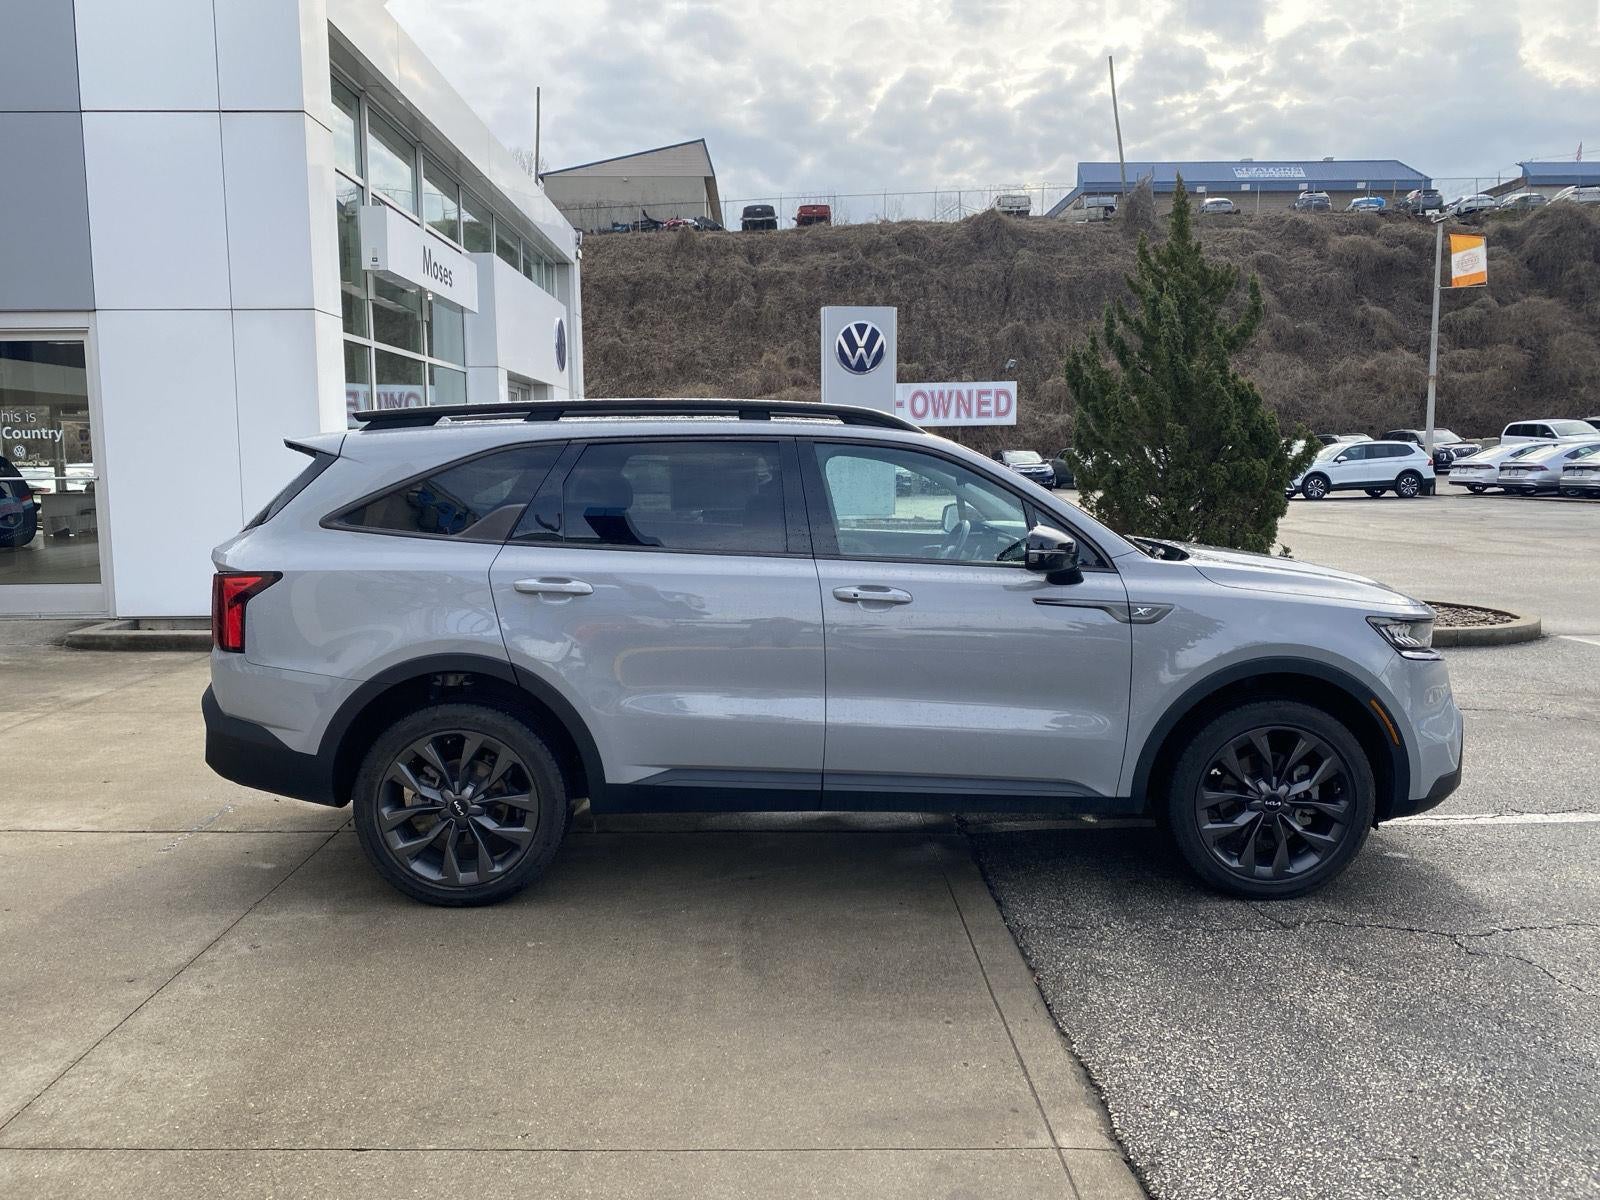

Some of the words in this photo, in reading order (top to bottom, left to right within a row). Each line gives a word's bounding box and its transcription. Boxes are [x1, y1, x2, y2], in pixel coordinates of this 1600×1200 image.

[422, 245, 453, 288] Moses
[836, 321, 886, 374] VW
[0, 410, 21, 422] his
[26, 410, 37, 422] is
[2, 426, 64, 443] Country
